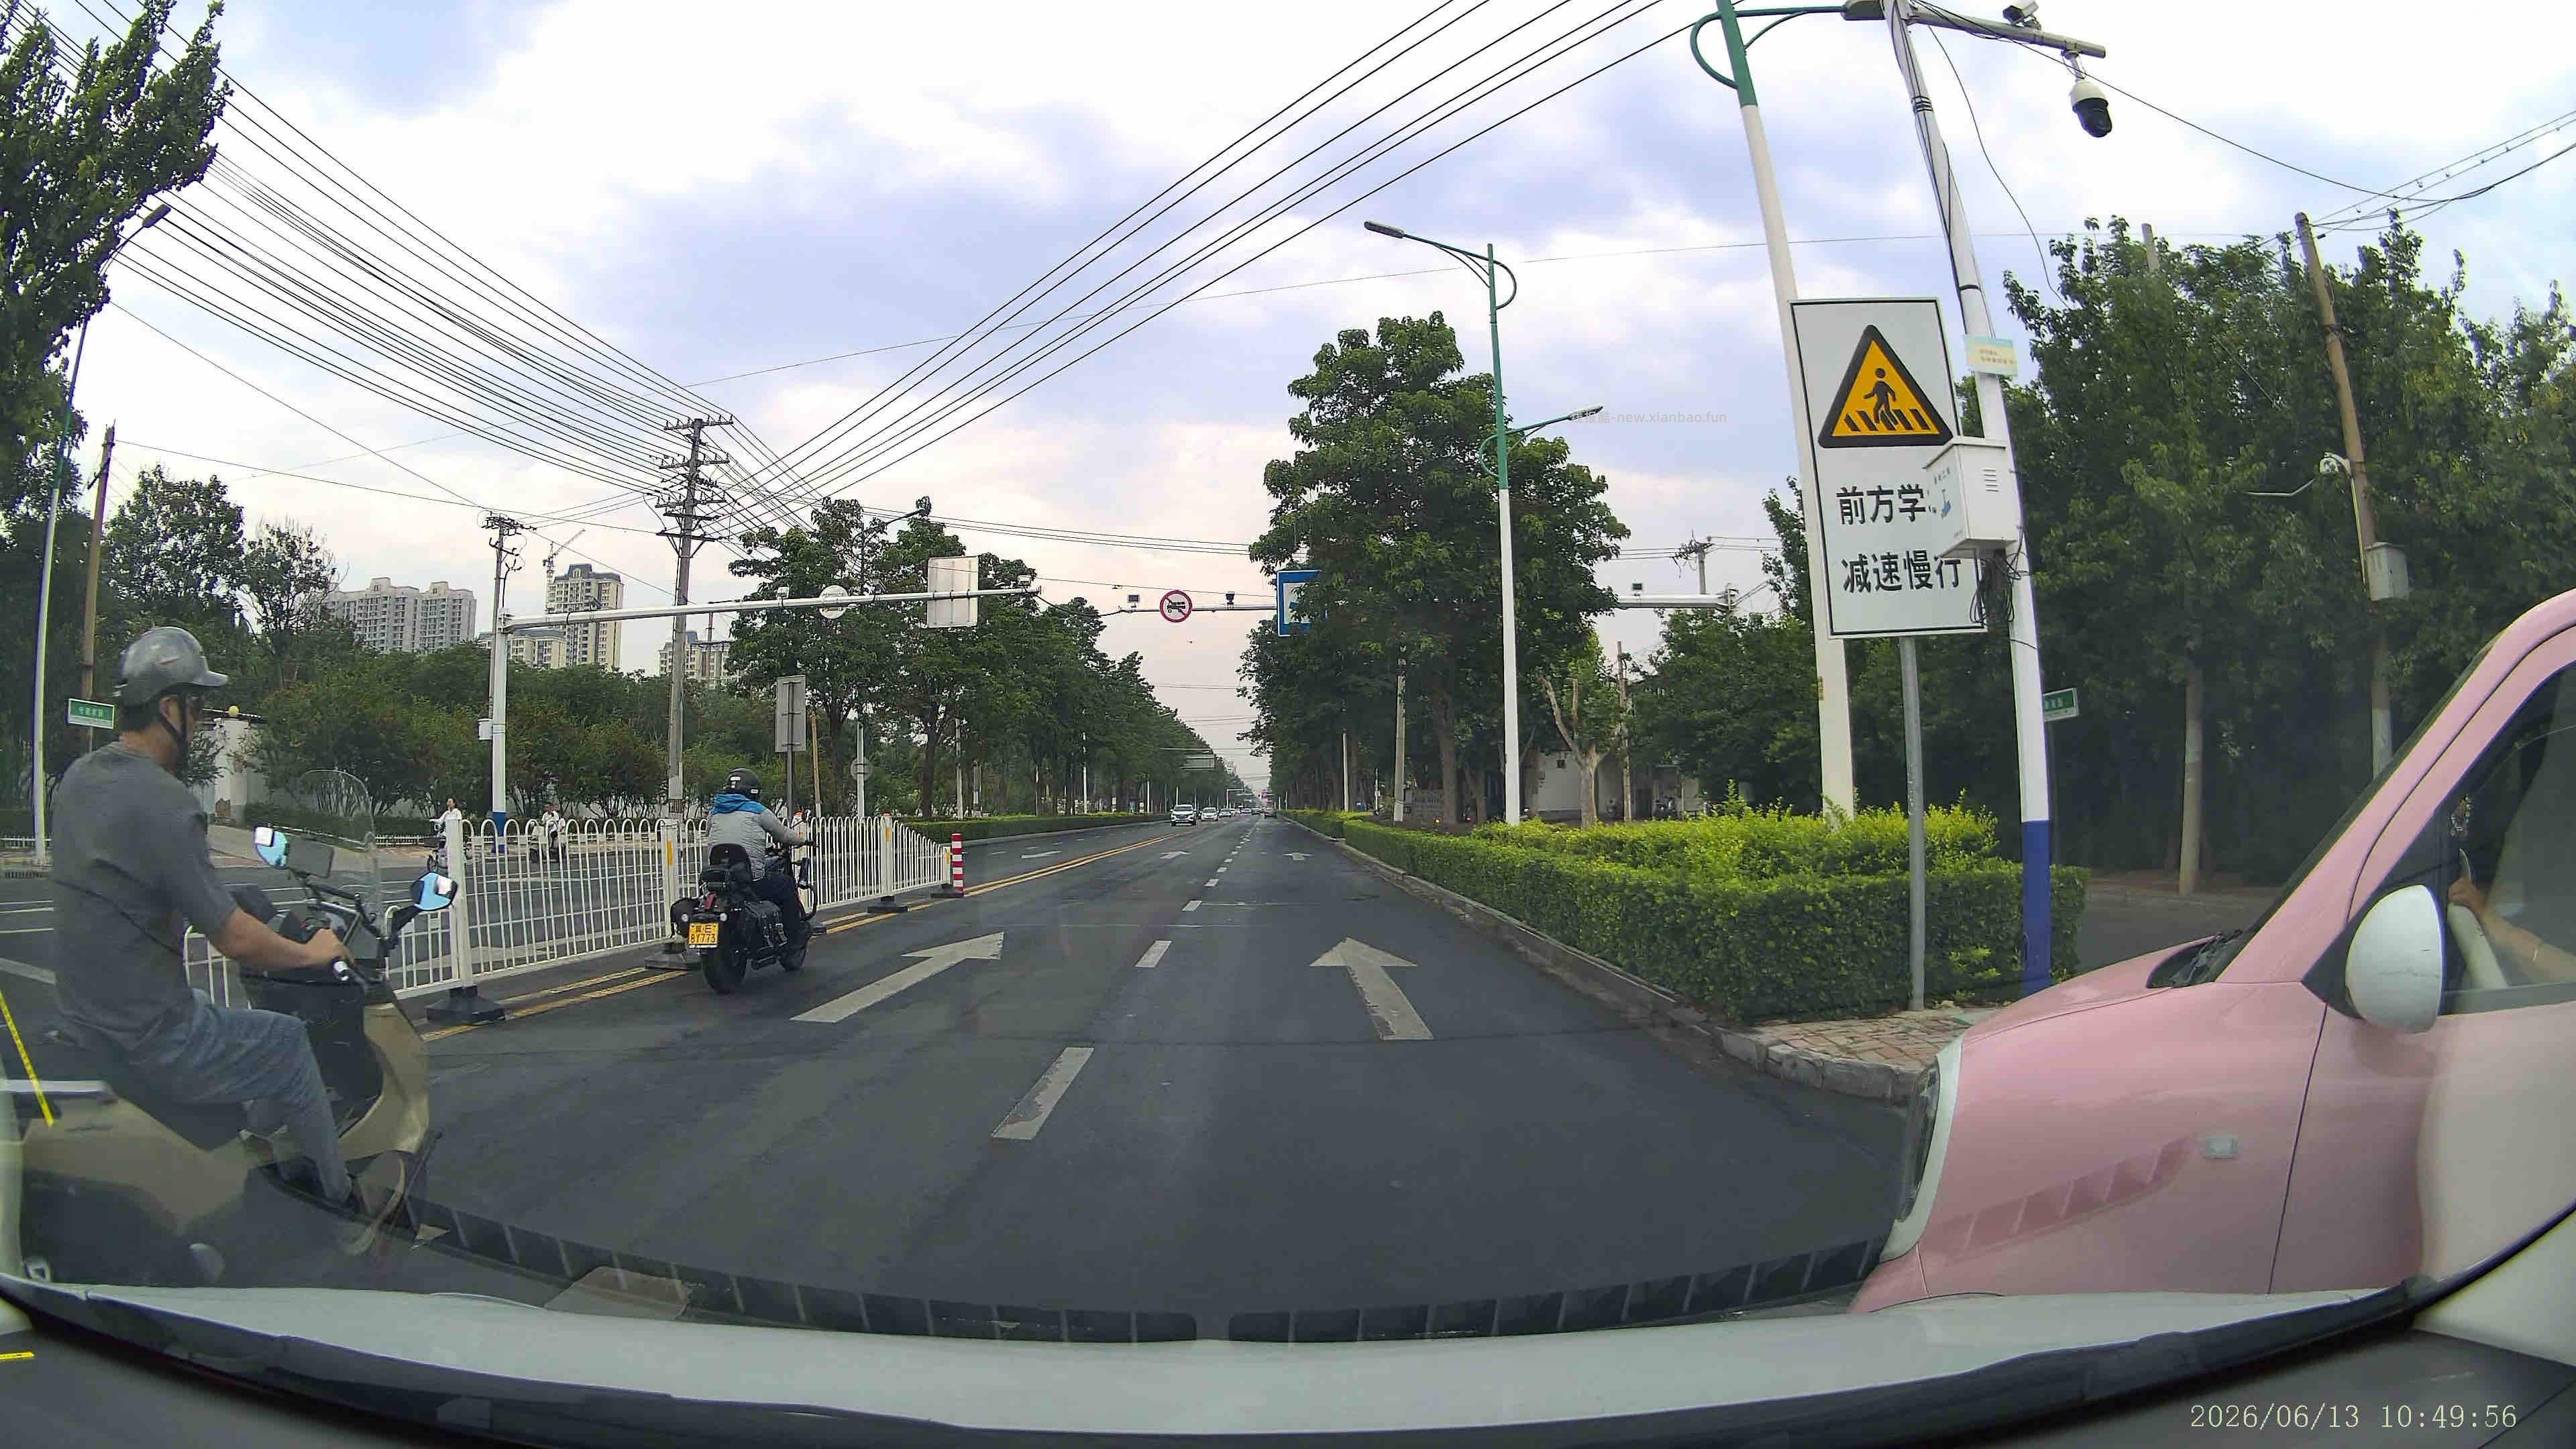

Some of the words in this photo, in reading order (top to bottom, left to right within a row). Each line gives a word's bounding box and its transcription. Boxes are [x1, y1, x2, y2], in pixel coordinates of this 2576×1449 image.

[1836, 484, 1932, 525] 前方学
[1841, 549, 1962, 593] 减速慢行
